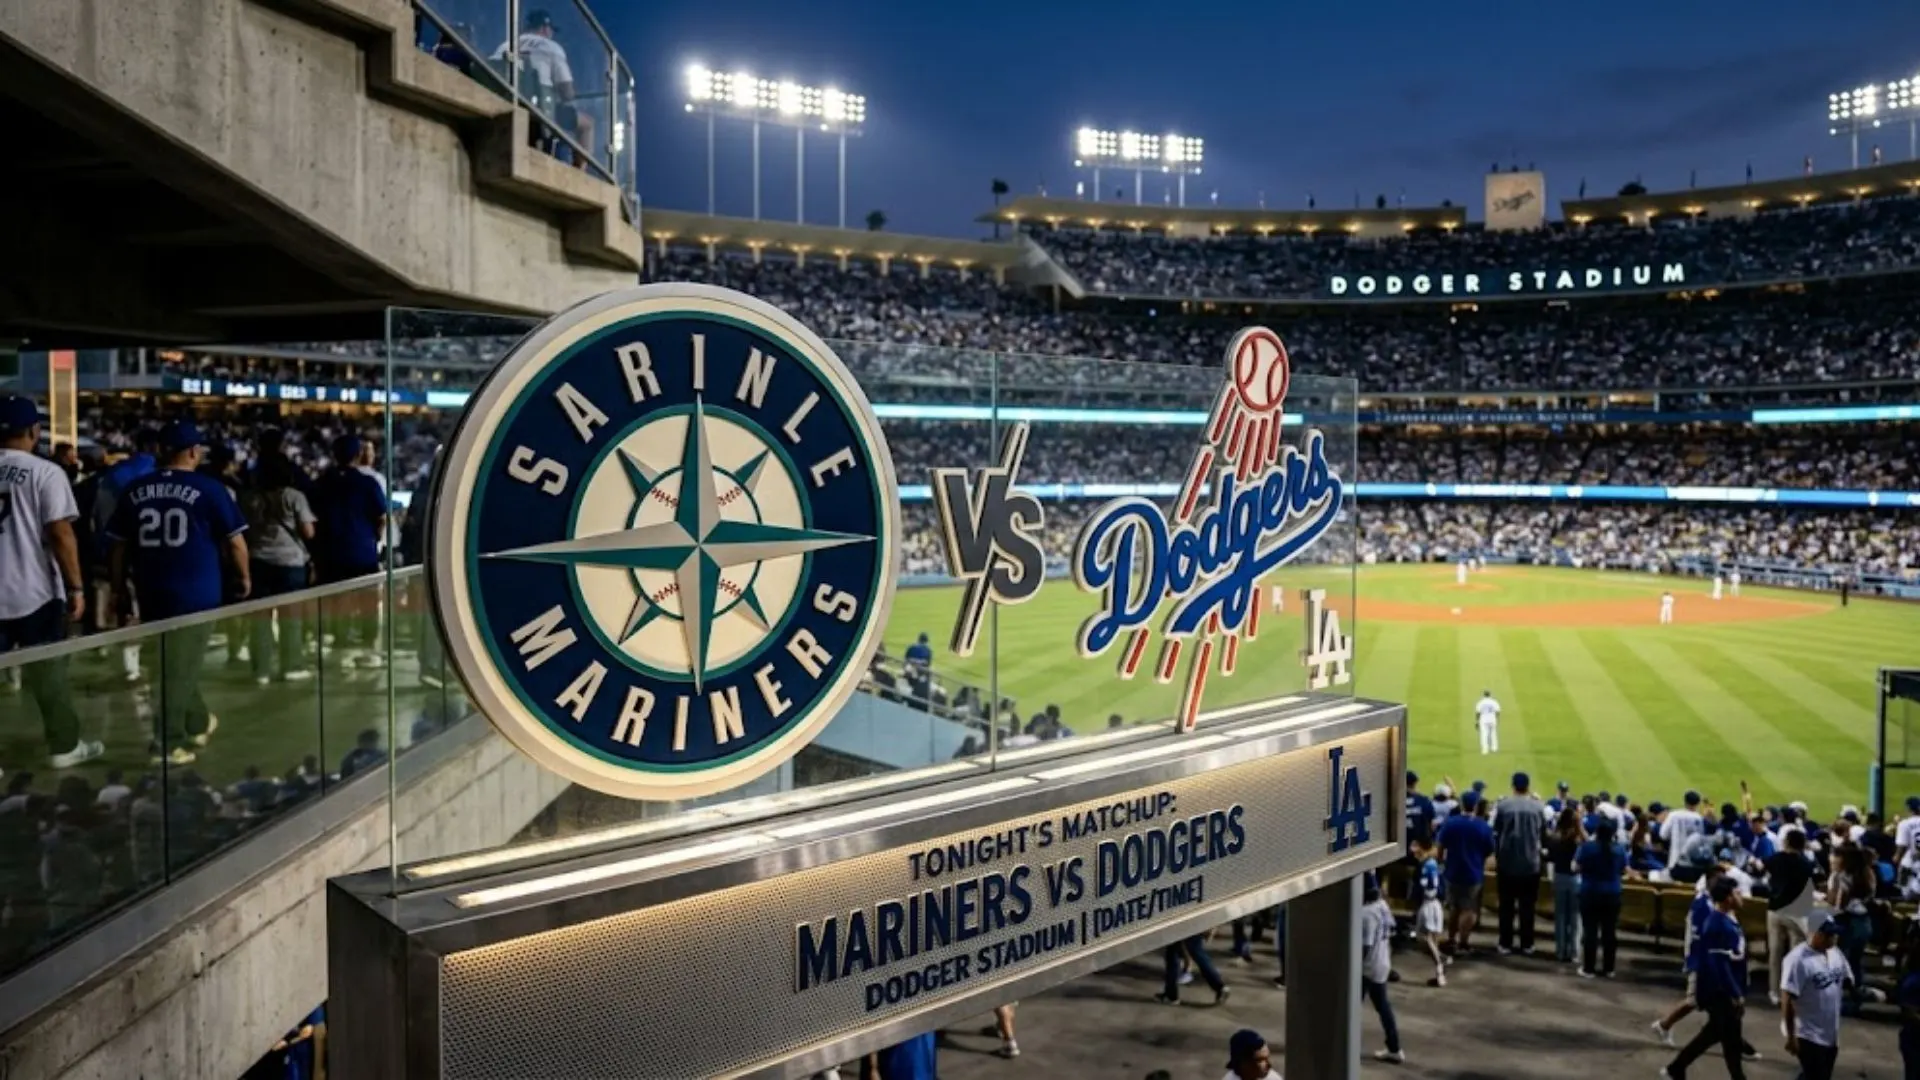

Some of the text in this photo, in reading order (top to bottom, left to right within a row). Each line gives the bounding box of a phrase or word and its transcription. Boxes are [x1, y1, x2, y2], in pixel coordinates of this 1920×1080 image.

[1331, 263, 1684, 294] DODGER STADIUM
[507, 333, 857, 496] SARINLE
[139, 508, 188, 547] 20
[931, 467, 1045, 604] VS
[1073, 430, 1343, 657] Dodgers
[510, 583, 858, 751] MARINERS
[1302, 588, 1352, 691] LA
[908, 792, 1177, 881] TONIGHT'S MATCHUP:
[1323, 746, 1371, 856] LA
[796, 804, 1246, 994] MARINERS VS DODGERS
[865, 953, 971, 1011] DODGER
[977, 918, 1075, 972] STADIUM
[1093, 875, 1204, 938] [DATE/TIME]
